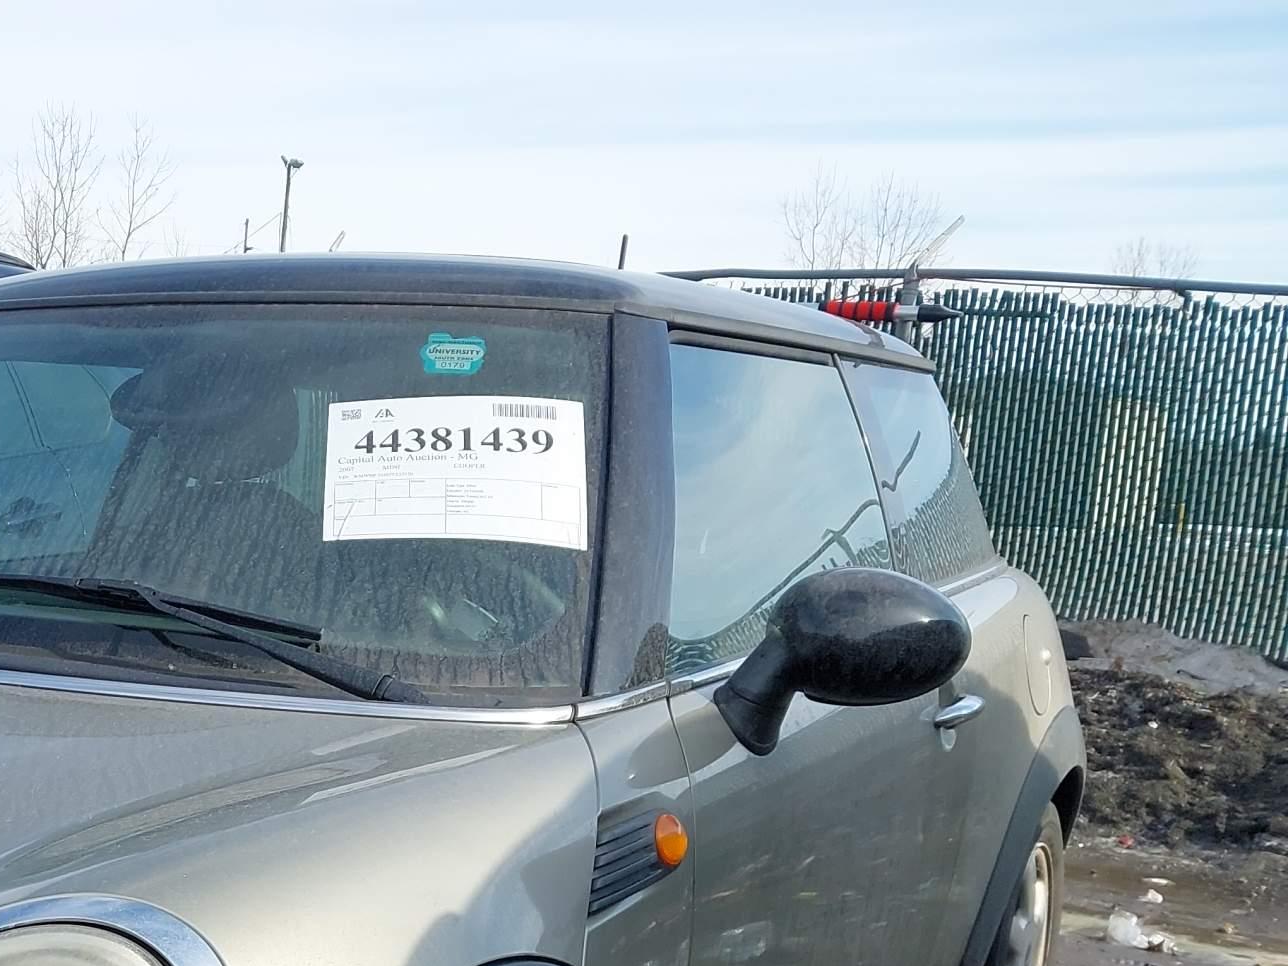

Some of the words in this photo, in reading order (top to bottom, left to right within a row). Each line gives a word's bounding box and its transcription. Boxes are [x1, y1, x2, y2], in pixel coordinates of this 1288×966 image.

[428, 346, 481, 355] UNIVERSITY
[354, 427, 554, 455] 44381439
[338, 455, 374, 465] Capital
[377, 455, 402, 463] Auto
